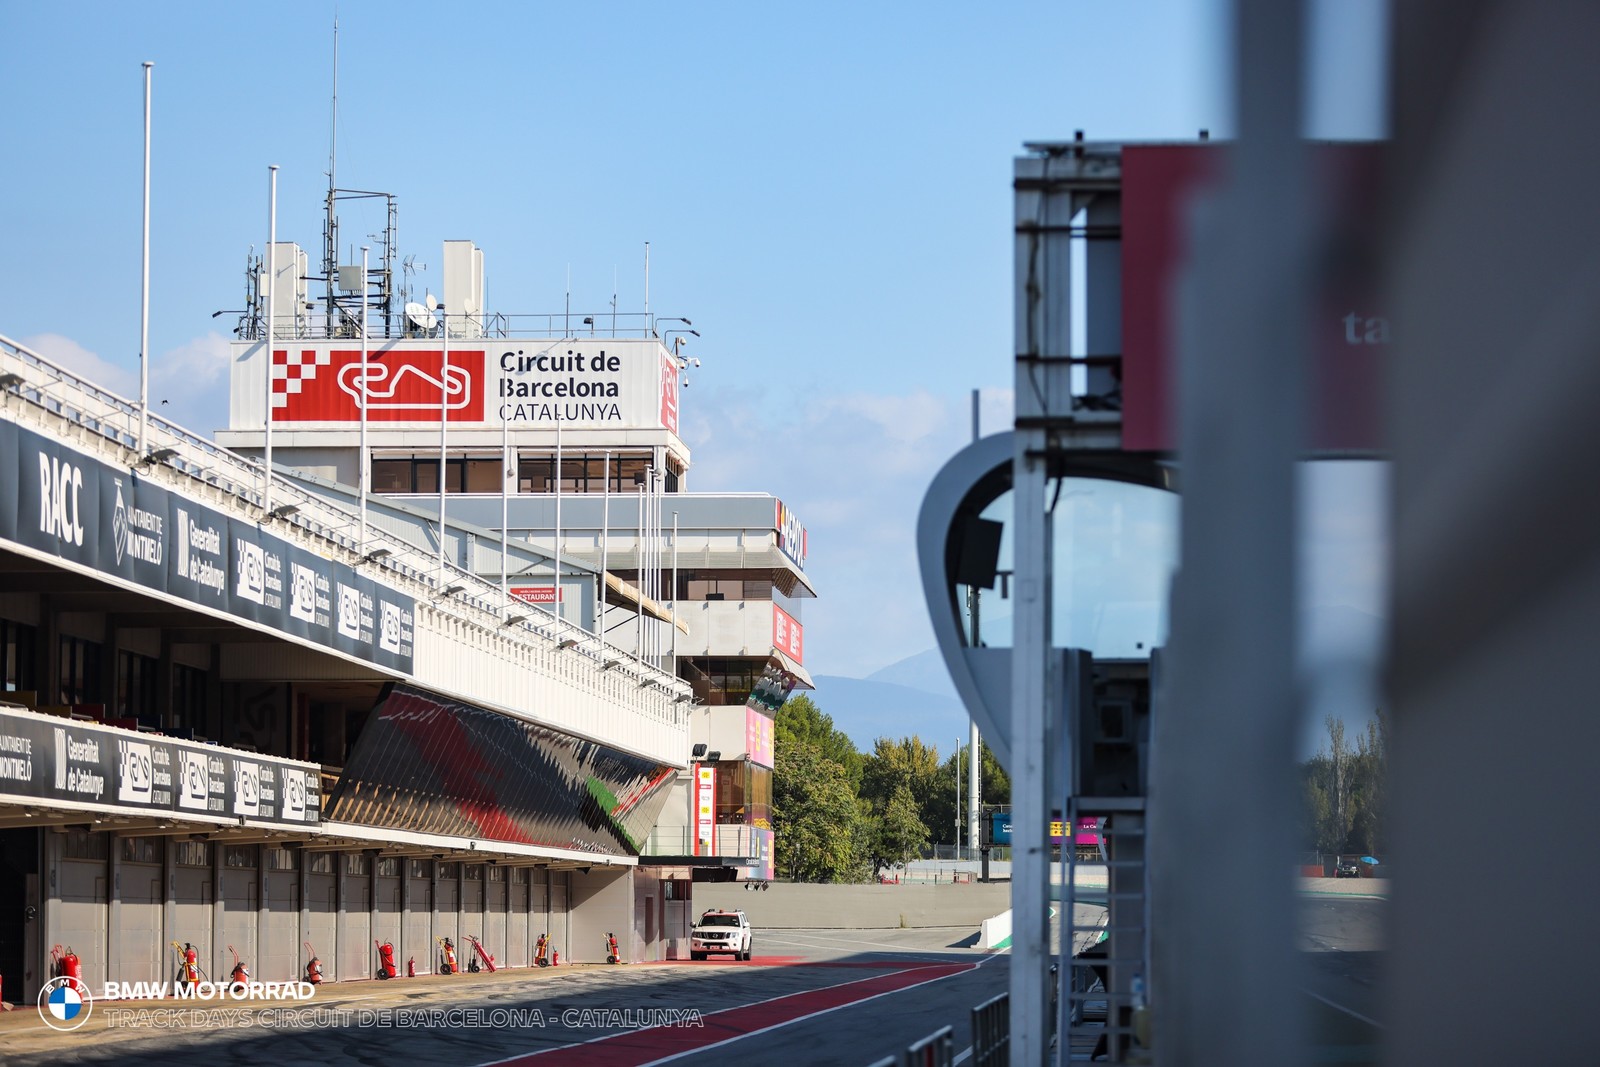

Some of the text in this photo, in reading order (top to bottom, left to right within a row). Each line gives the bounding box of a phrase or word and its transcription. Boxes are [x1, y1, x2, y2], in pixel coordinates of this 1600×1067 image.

[500, 350, 621, 372] Circuit de
[499, 377, 619, 398] Barcelona
[499, 403, 622, 421] CATALUNYA
[38, 450, 84, 547] RACC
[67, 735, 100, 764] Generalitat
[67, 767, 104, 800] de Catalunya
